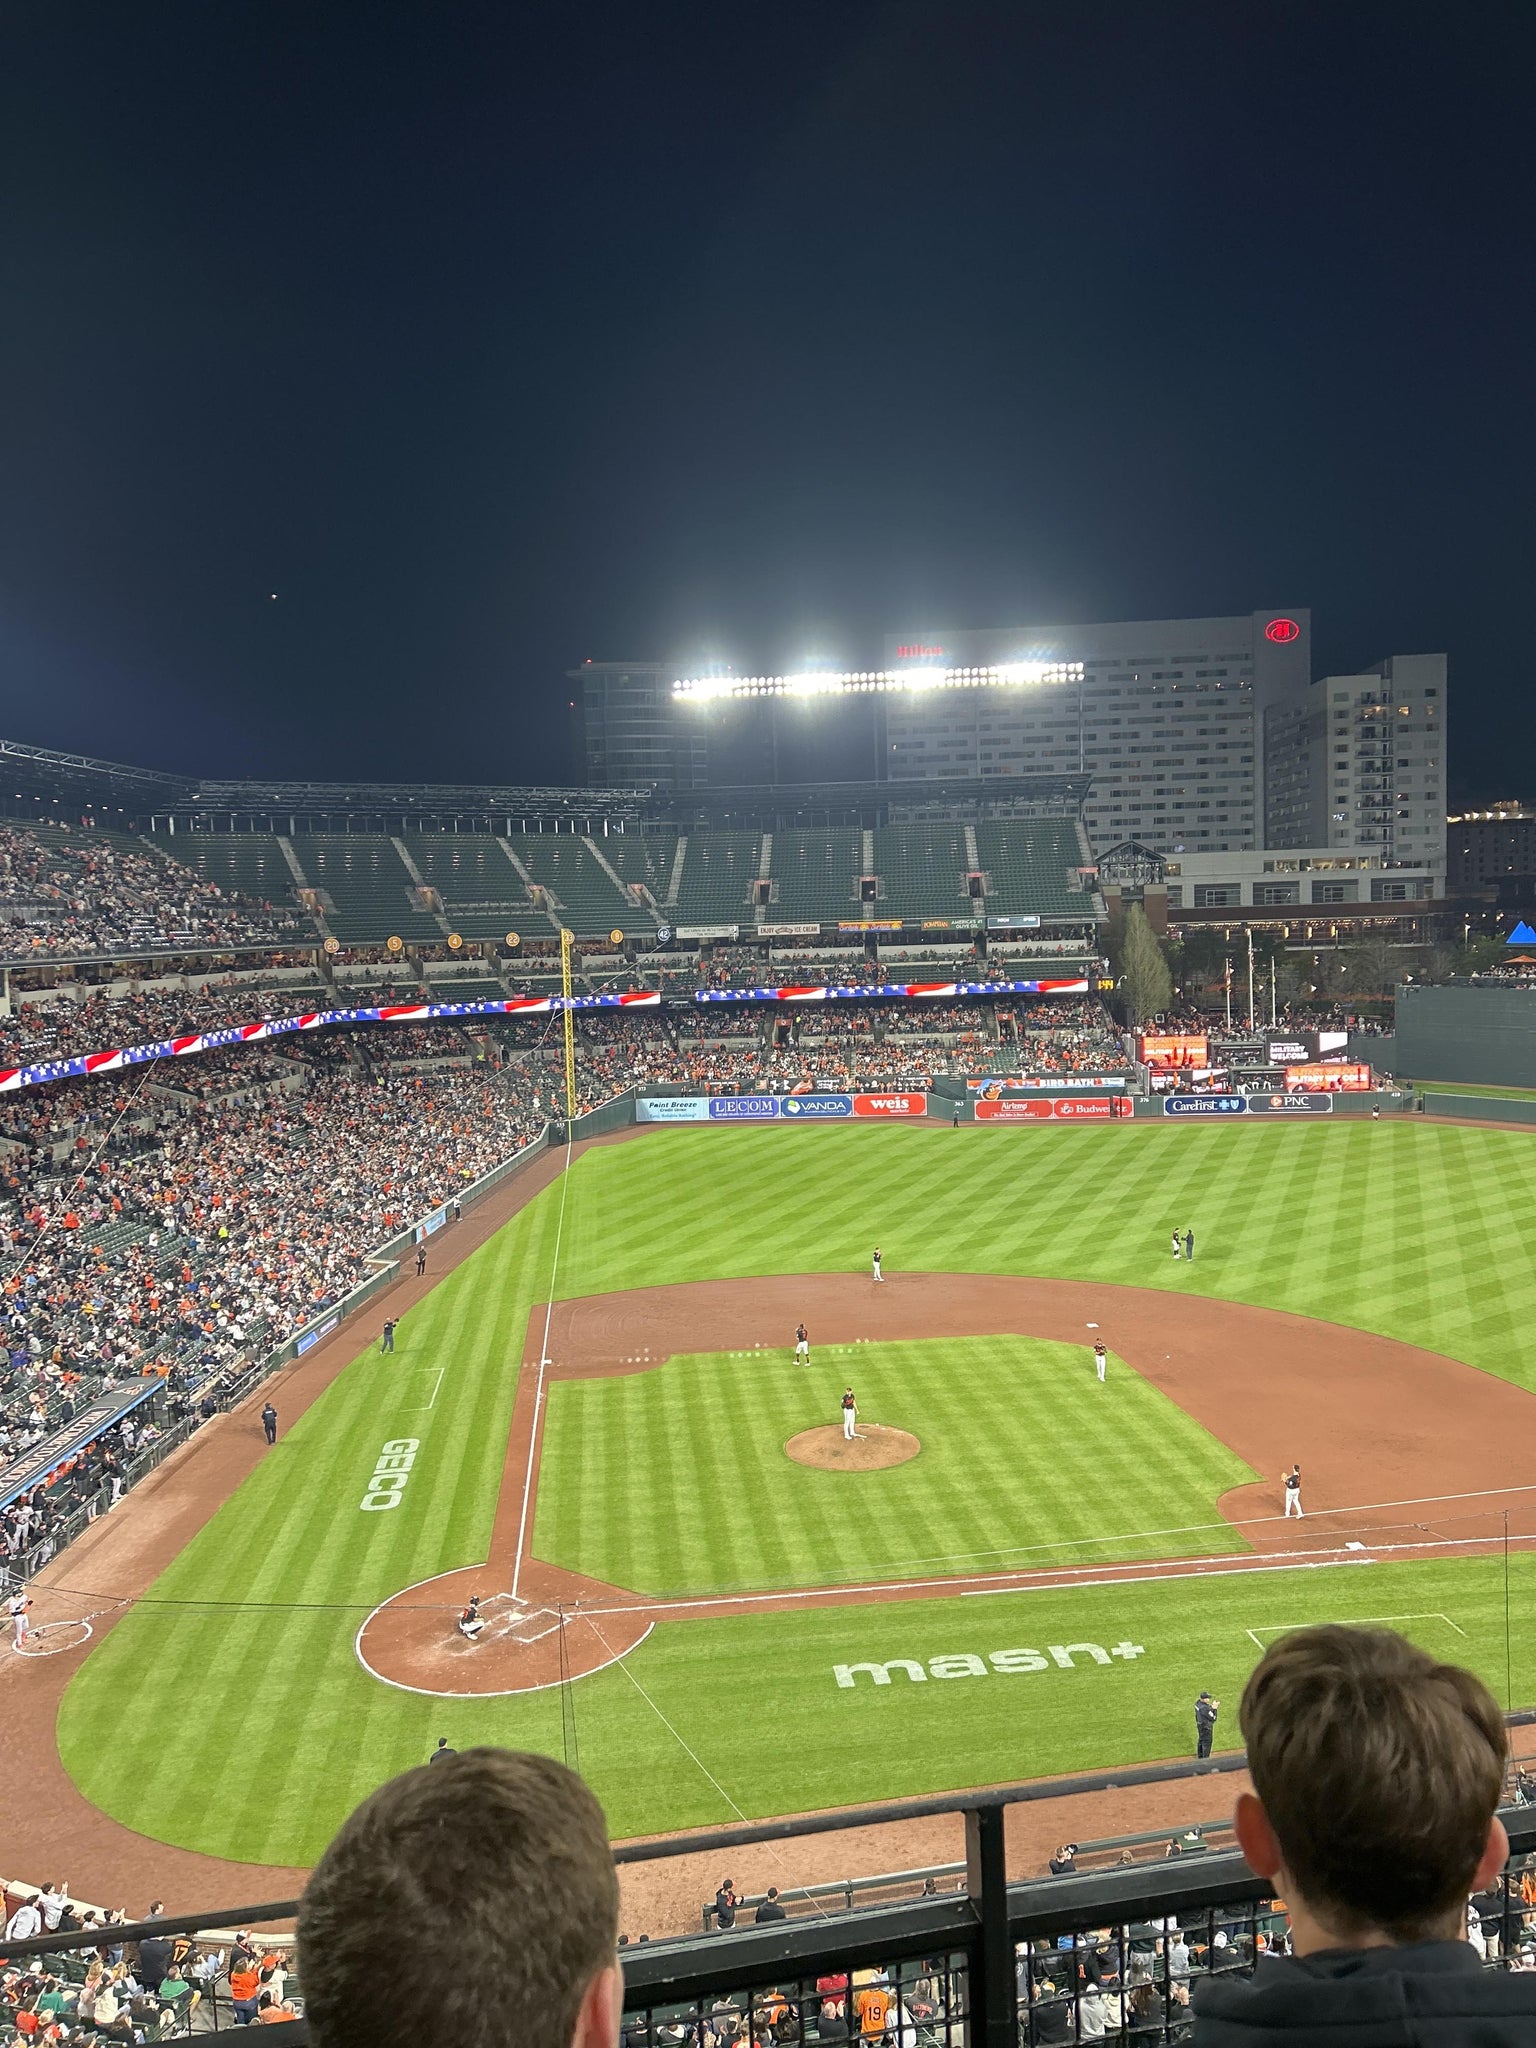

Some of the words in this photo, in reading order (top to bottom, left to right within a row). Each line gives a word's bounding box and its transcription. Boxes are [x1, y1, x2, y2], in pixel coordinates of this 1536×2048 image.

[897, 644, 943, 658] Hilton
[659, 930, 668, 939] 42
[1040, 1078, 1066, 1087] BIRD
[1068, 1078, 1095, 1086] BATH
[715, 1100, 773, 1113] LECOM
[800, 1101, 846, 1110] VANDA
[870, 1096, 909, 1109] weis
[1002, 1101, 1028, 1111] Airtemp
[1284, 1097, 1309, 1106] PNC
[360, 1438, 421, 1511] GEICO
[173, 1945, 189, 1963] 17
[868, 2006, 881, 2021] 19
